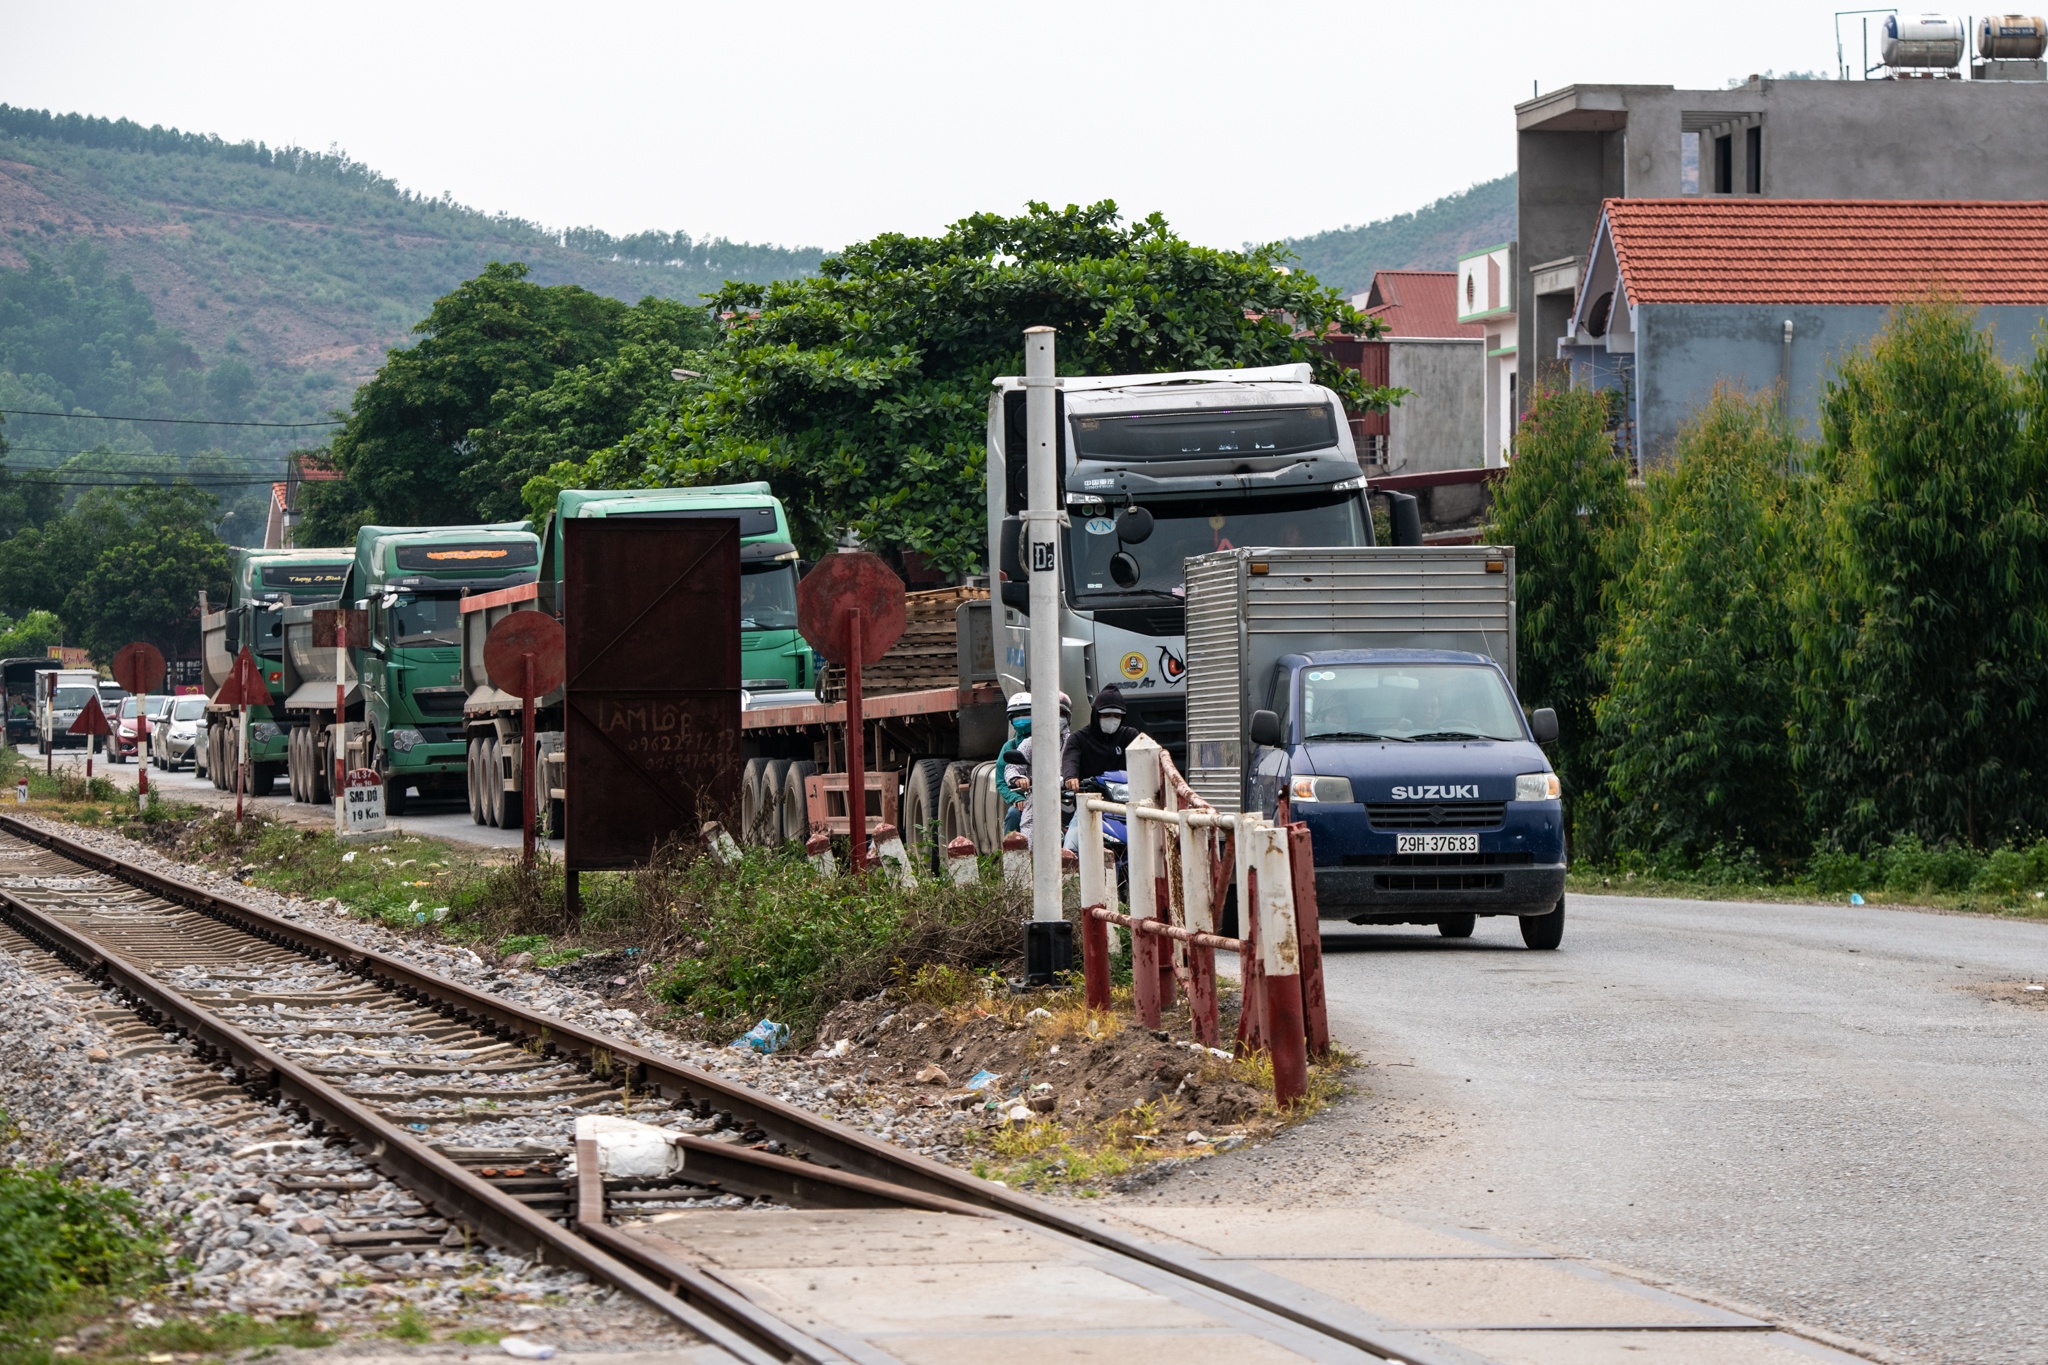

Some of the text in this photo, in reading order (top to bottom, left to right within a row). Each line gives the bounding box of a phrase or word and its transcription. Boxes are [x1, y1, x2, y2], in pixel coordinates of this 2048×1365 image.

[1089, 520, 1113, 532] VN
[361, 770, 372, 778] 37
[18, 788, 26, 799] N
[1391, 784, 1480, 800] SUZUKI
[352, 808, 379, 822] 19 Km
[1399, 836, 1477, 852] 29H-376.83
